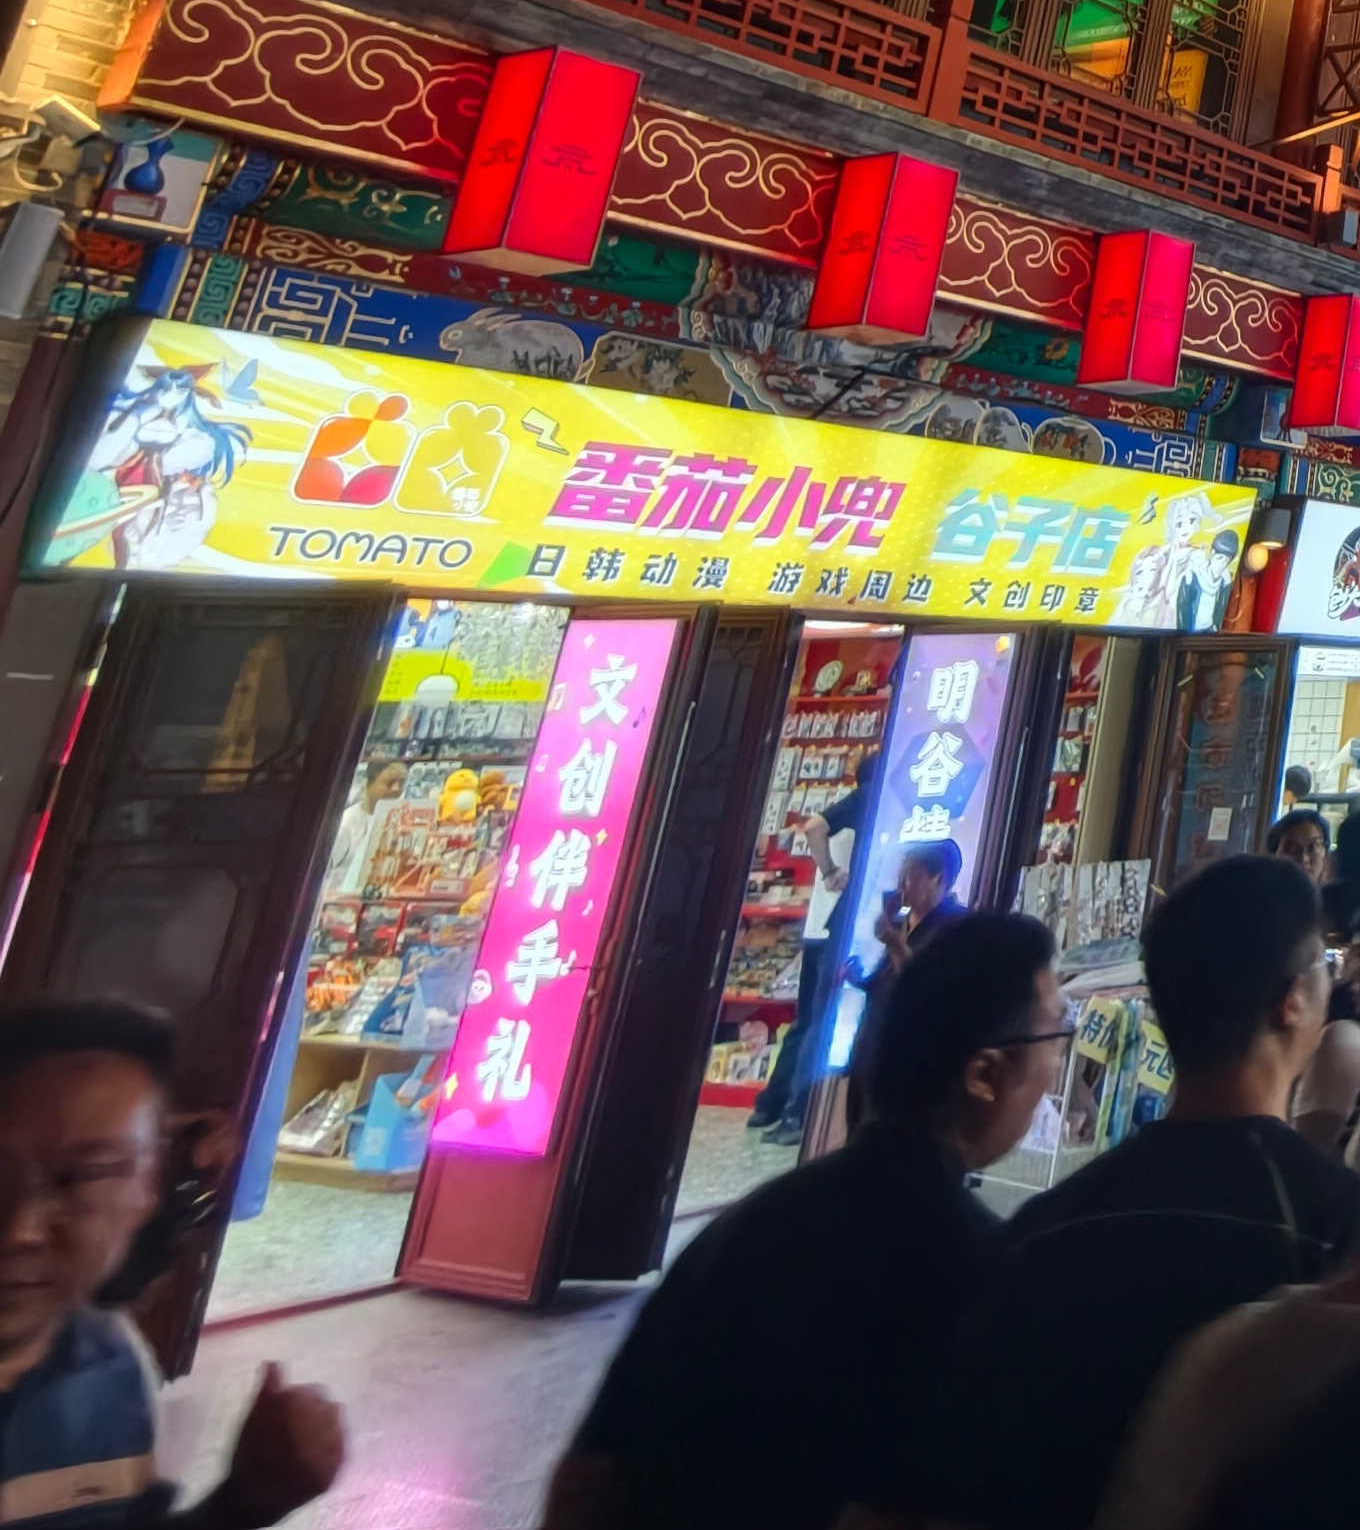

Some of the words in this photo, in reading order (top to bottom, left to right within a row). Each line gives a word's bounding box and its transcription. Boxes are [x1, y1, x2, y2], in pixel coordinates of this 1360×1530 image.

[269, 526, 474, 568] TOMATO
[544, 440, 907, 555] 番茄小兜
[931, 487, 1133, 576] 谷子店
[526, 544, 731, 591] 日韩动漫
[767, 560, 933, 604] 游戏周边
[966, 577, 1101, 614] 文创印章
[477, 653, 638, 1103] 文创伴手礼
